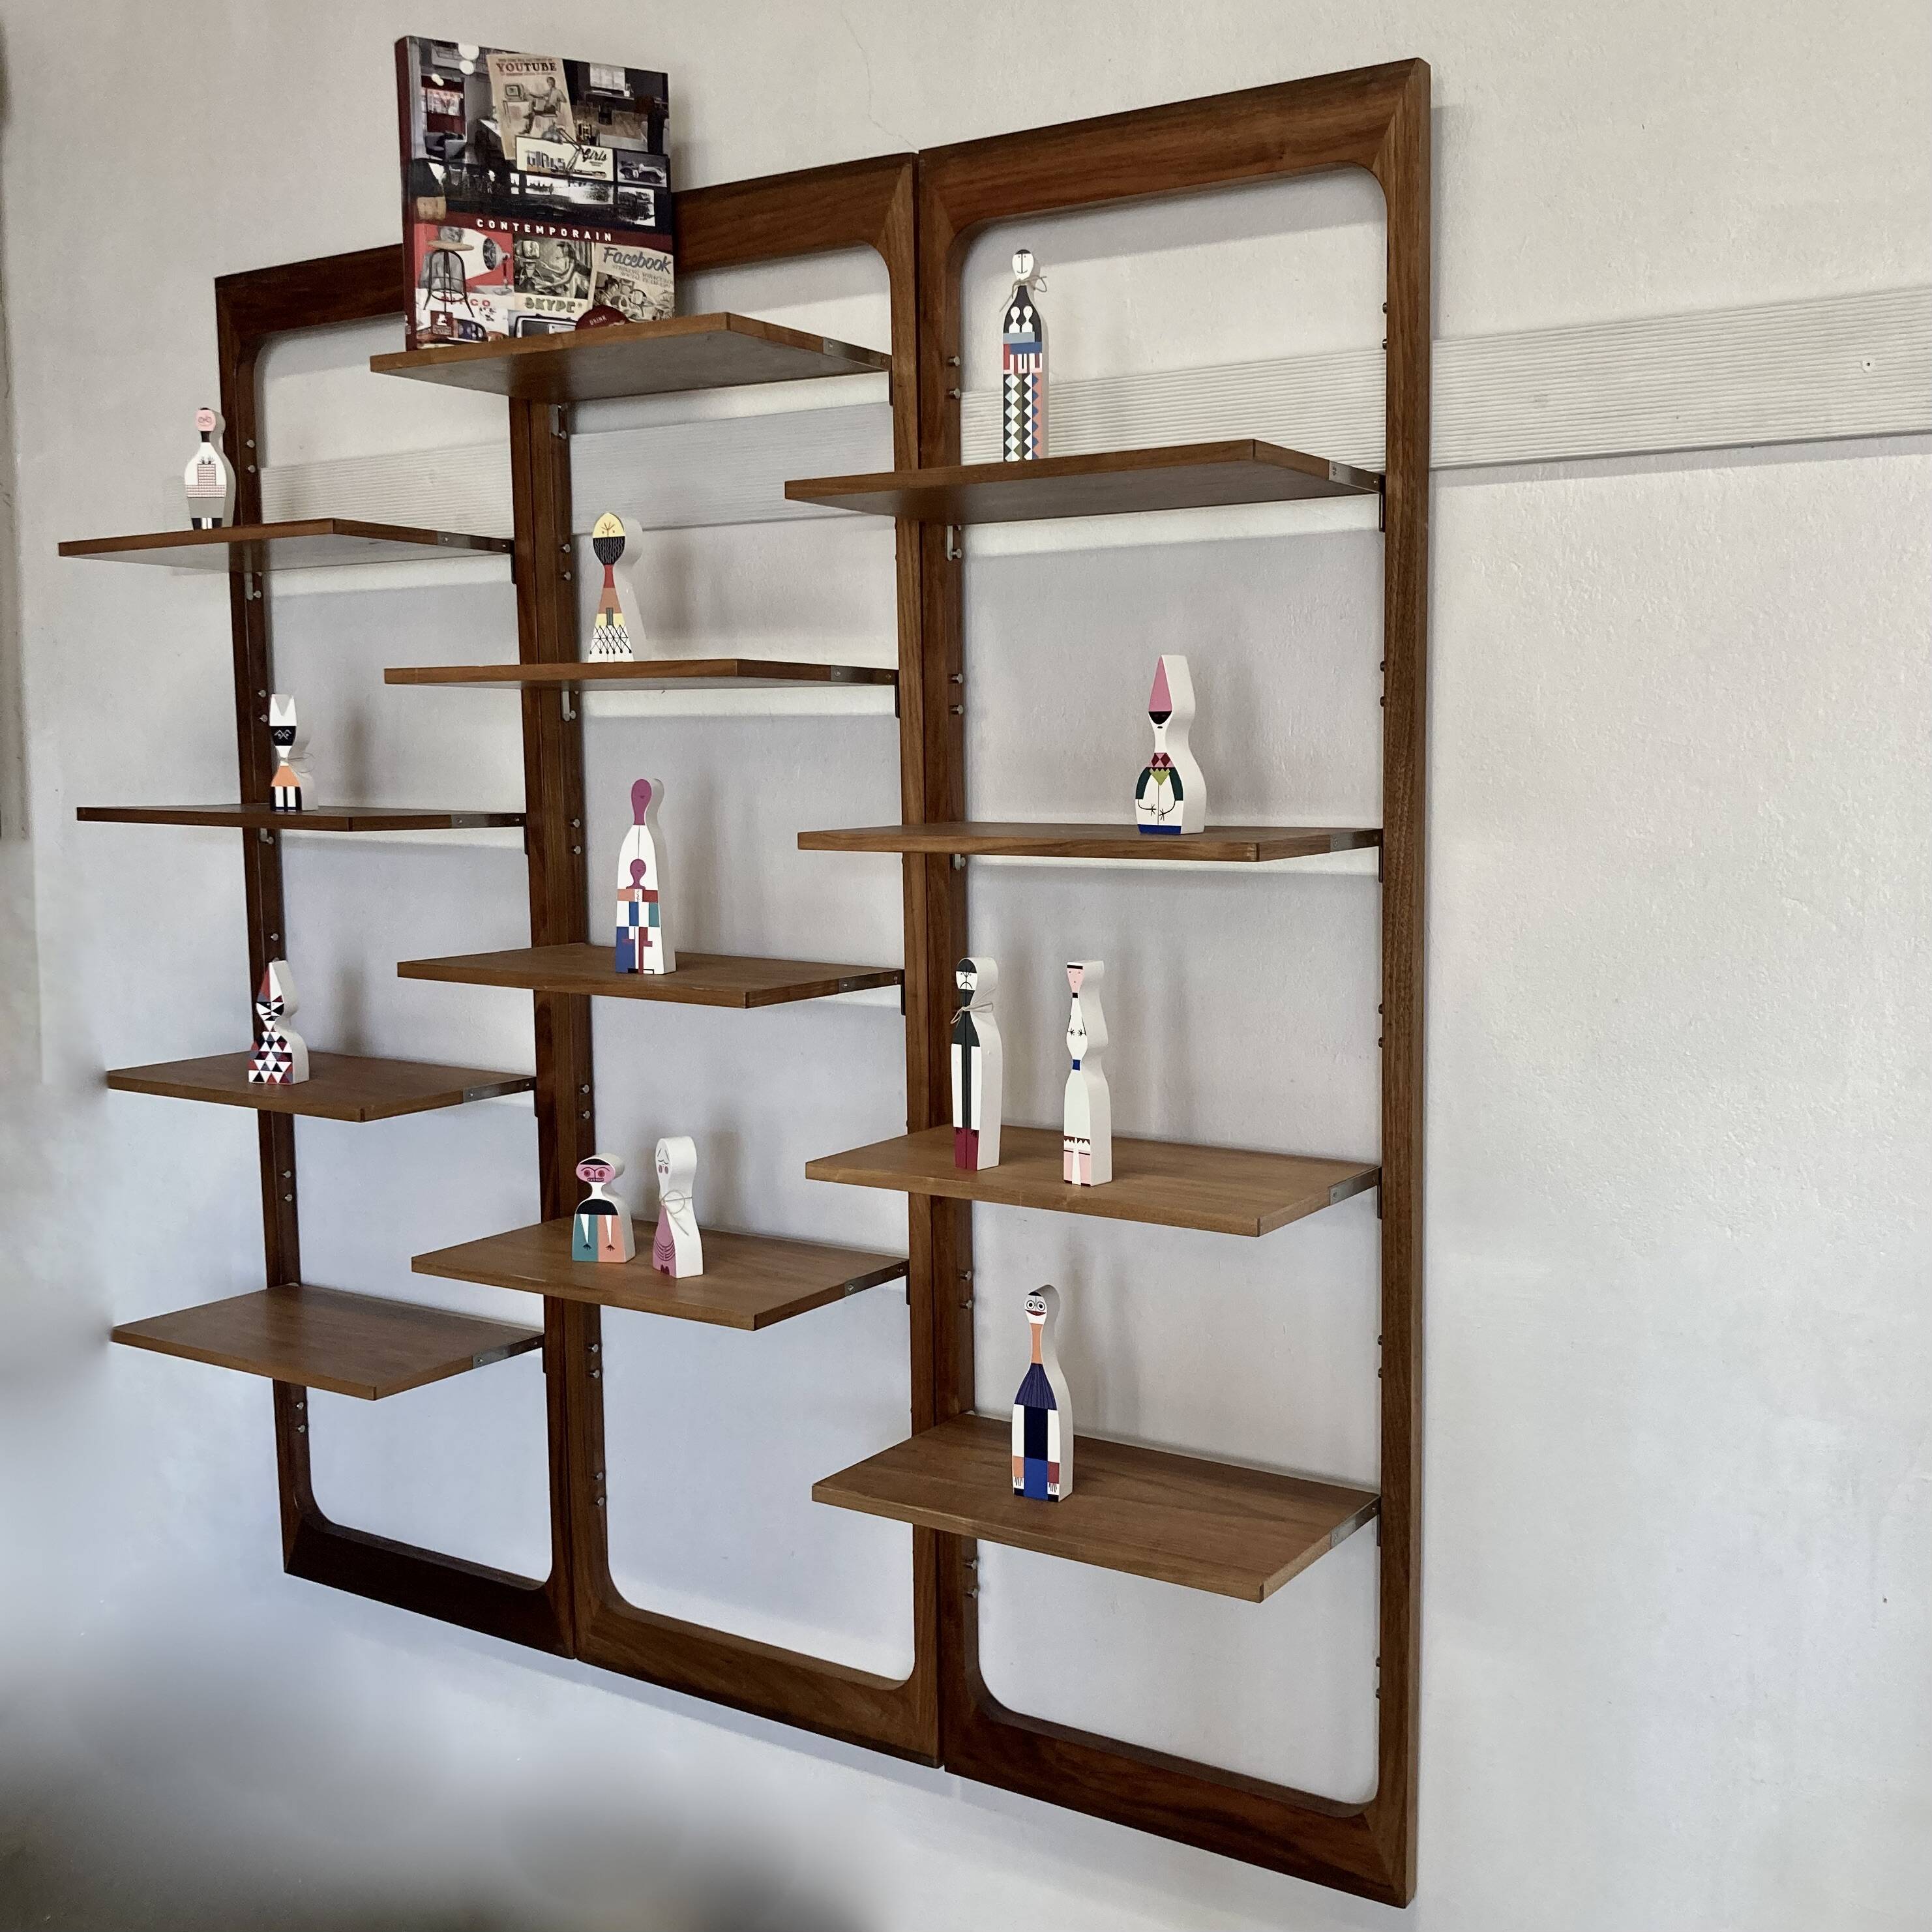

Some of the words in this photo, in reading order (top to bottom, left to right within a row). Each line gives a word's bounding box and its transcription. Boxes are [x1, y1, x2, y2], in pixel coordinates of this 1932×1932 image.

[496, 62, 557, 72] YOUTUBE
[582, 148, 607, 162] Girls
[476, 218, 612, 241] CONTEMPORAIN
[603, 246, 671, 275] Facebook
[526, 297, 576, 313] SKYPE
[589, 315, 607, 325] DRINK
